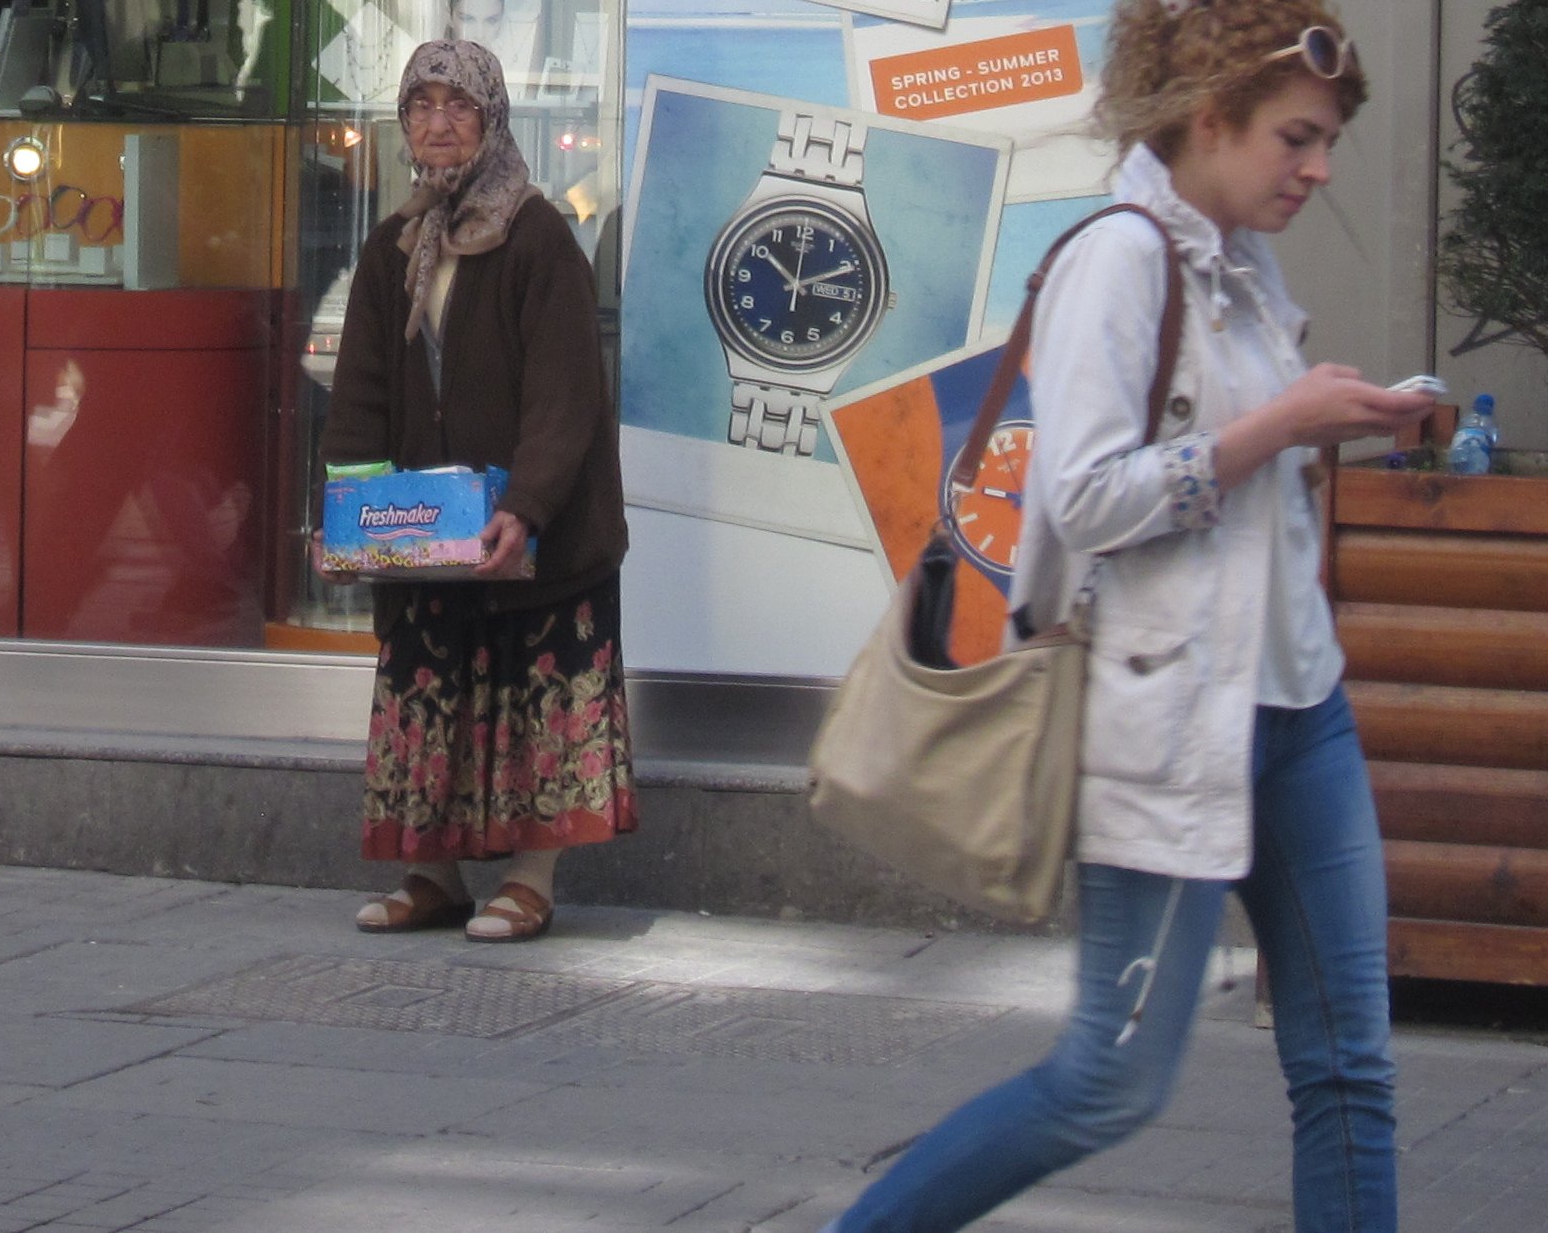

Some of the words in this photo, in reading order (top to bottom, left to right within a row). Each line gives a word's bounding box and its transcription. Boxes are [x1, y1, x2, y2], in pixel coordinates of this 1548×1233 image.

[890, 66, 962, 91] SPRING
[977, 48, 1060, 76] SUMMER
[894, 76, 1014, 111] COLLECTION
[1020, 68, 1064, 88] 2013
[751, 244, 769, 259] 10
[738, 269, 752, 282] 9
[815, 285, 839, 296] WED
[740, 295, 754, 309] 8
[759, 318, 772, 332] 7
[829, 311, 843, 325] 4
[781, 330, 795, 344] 6
[806, 327, 821, 341] 5
[988, 431, 1016, 456] 12
[360, 502, 440, 527] Freshmaker
